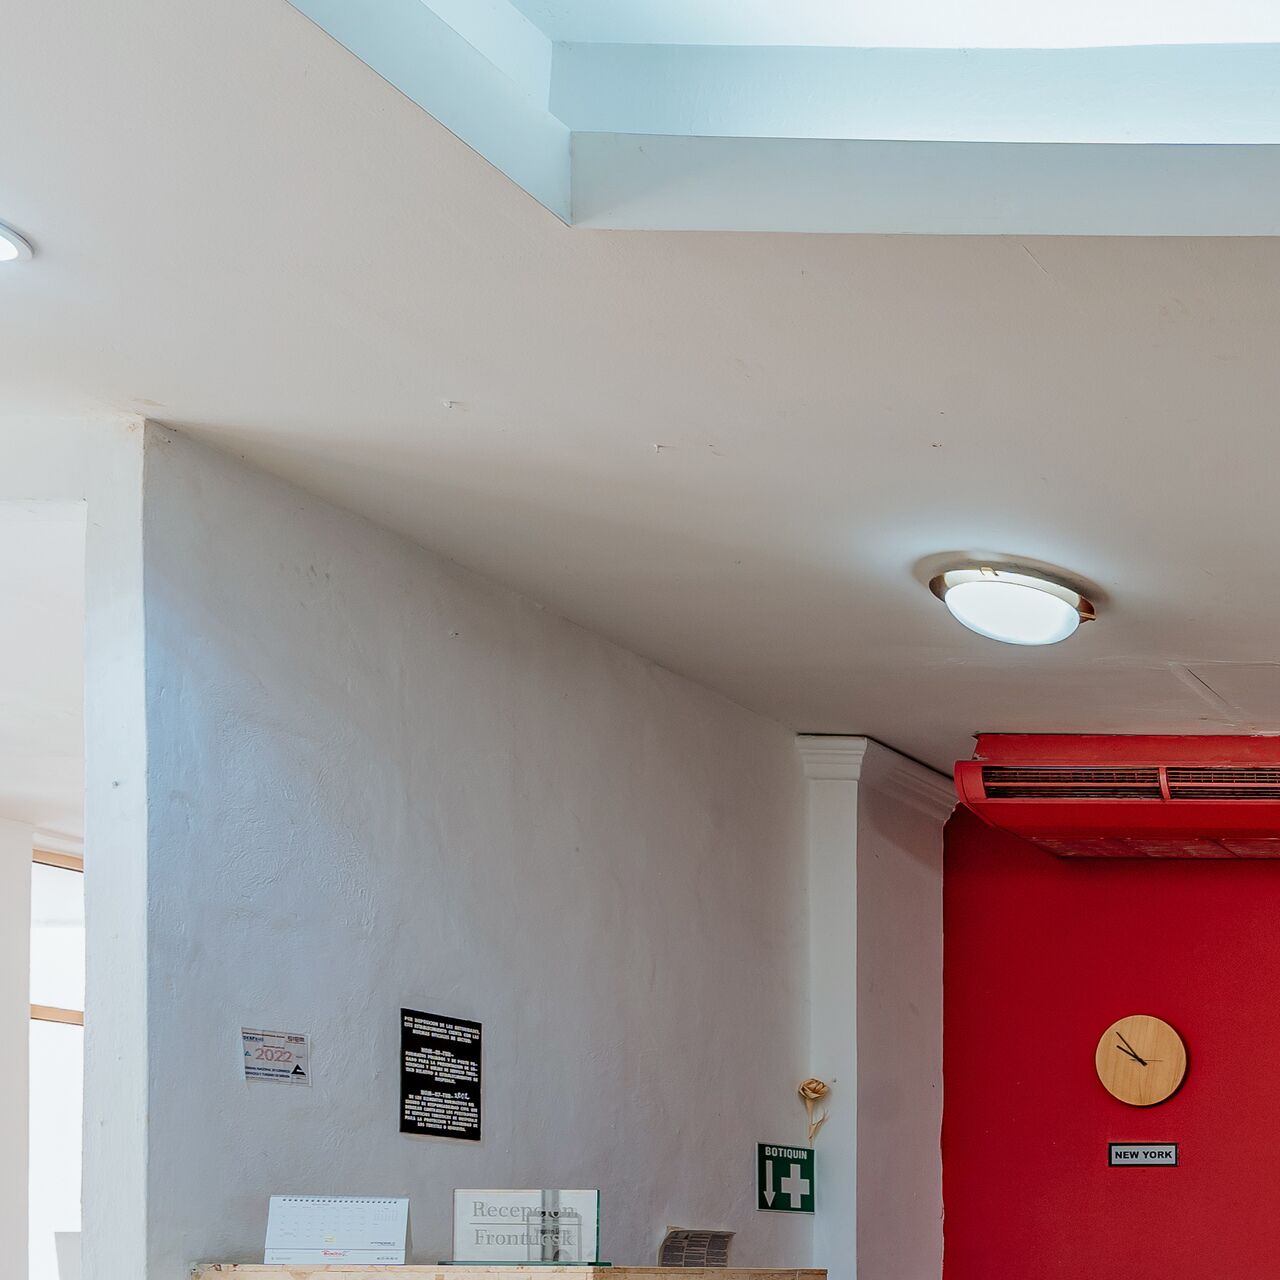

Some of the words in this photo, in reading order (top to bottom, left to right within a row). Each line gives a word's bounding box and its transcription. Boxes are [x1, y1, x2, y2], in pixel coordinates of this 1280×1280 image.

[255, 1048, 292, 1063] 2022
[764, 1146, 808, 1160] BOTIQUIN
[1115, 1151, 1139, 1159] NEW
[1142, 1151, 1172, 1159] YORK
